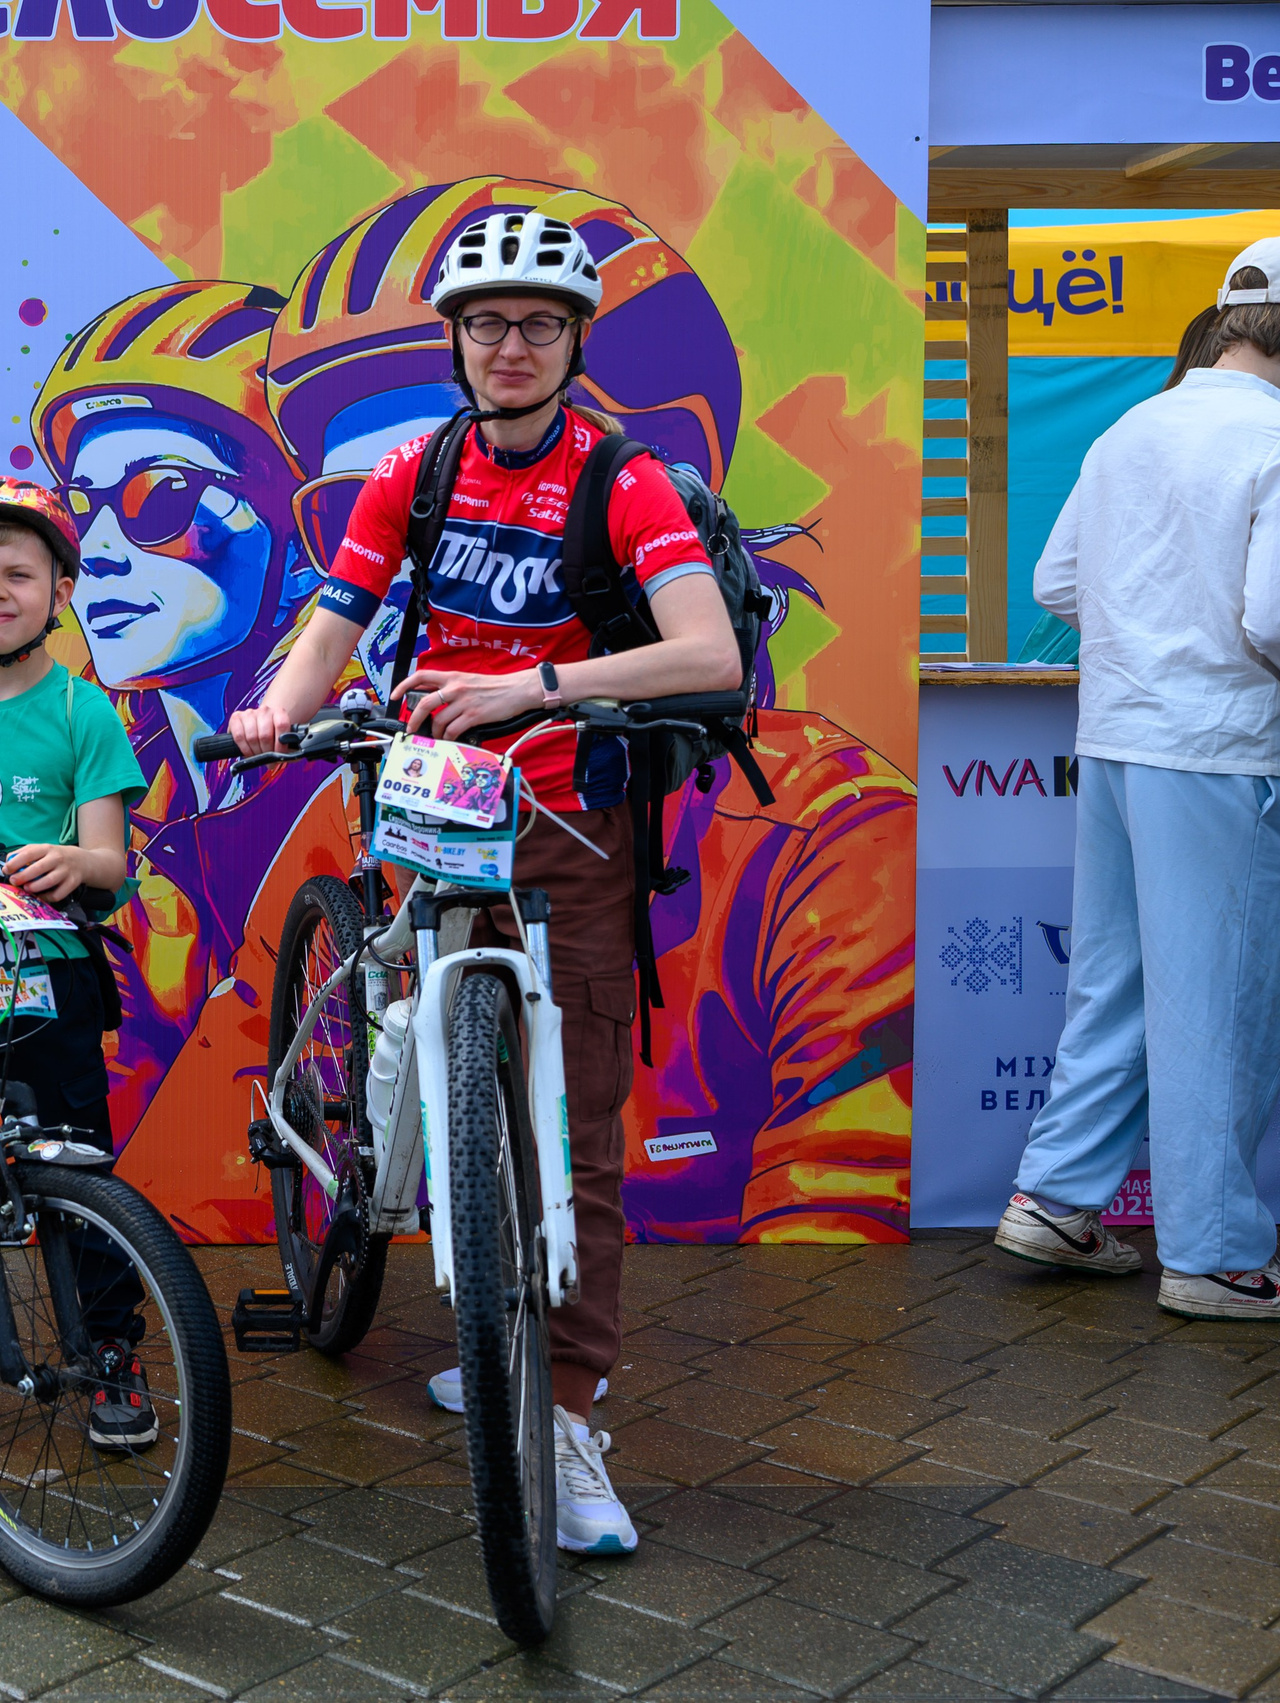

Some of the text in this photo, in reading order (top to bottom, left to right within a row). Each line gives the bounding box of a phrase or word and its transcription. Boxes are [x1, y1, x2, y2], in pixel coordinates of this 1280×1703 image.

[383, 779, 431, 799] 00678
[1, 913, 29, 923] 0679
[1011, 1193, 1031, 1207] NIKE
[1101, 1197, 1154, 1217] 025
